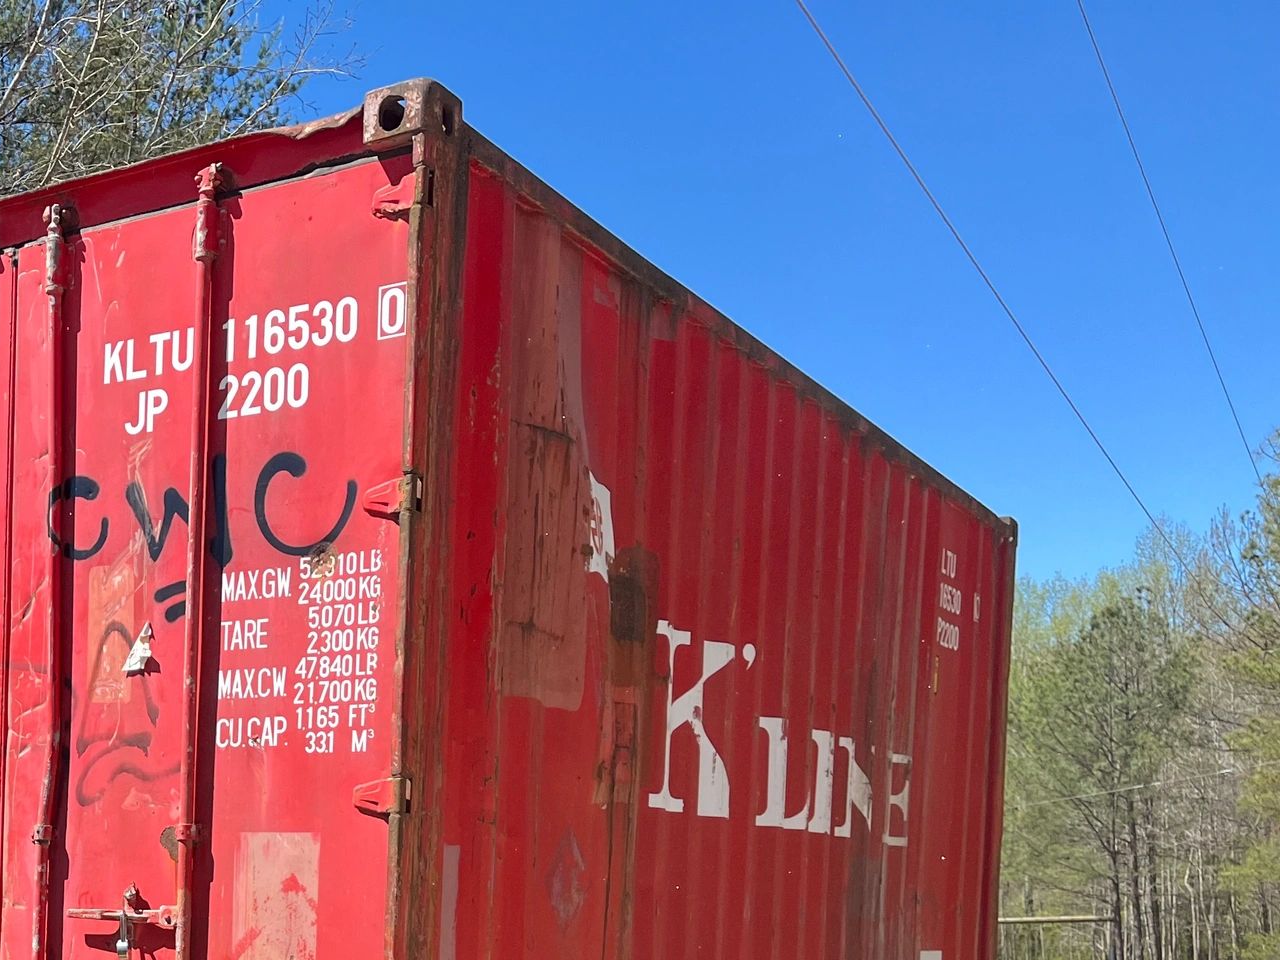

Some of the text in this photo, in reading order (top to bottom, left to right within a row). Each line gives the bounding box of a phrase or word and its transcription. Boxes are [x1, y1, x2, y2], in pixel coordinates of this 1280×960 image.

[103, 286, 406, 385] KLTU 116530 0
[124, 362, 309, 435] JP 2200
[358, 575, 380, 599] KG
[221, 618, 269, 651] TARE
[356, 626, 380, 651] KG
[354, 677, 377, 702] KG
